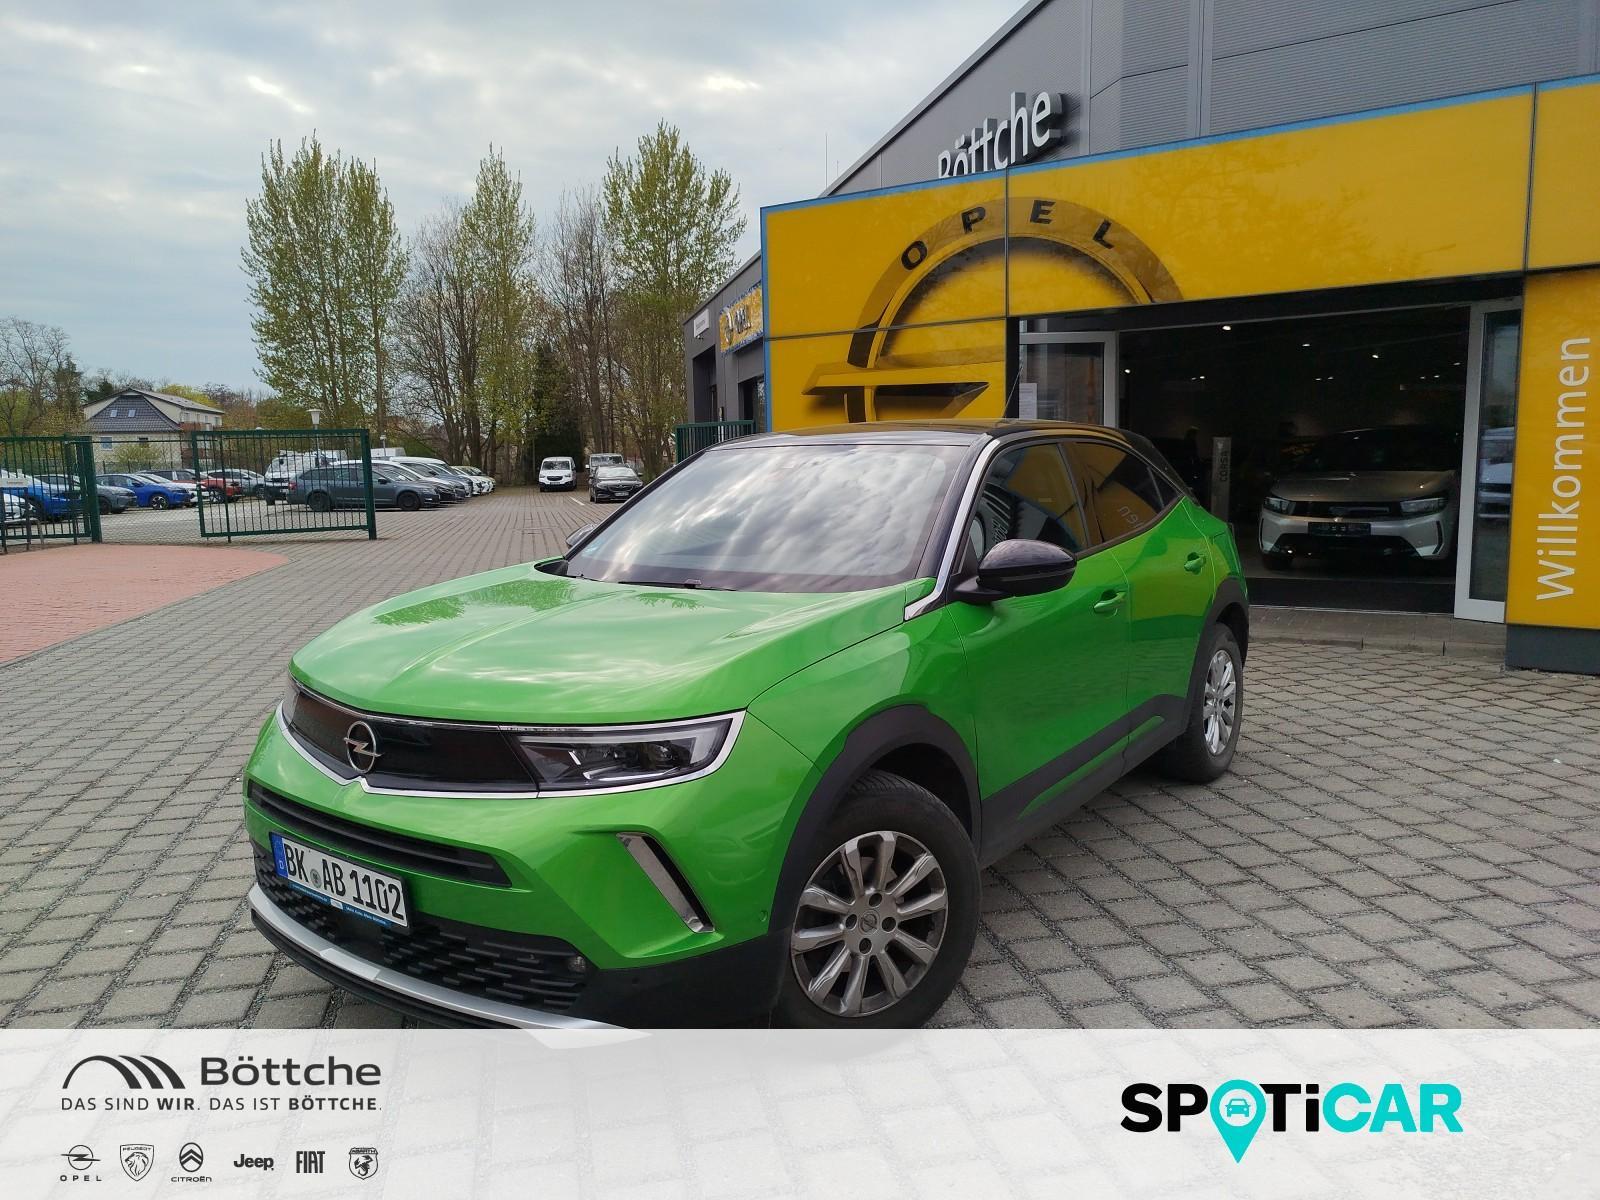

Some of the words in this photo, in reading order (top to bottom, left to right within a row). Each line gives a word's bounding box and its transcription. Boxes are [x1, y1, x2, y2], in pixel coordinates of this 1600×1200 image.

[901, 199, 1115, 271] OPEL
[1536, 338, 1591, 600] Willkommen
[284, 843, 309, 882] BK
[322, 859, 346, 896] AB
[350, 869, 404, 920] 1102
